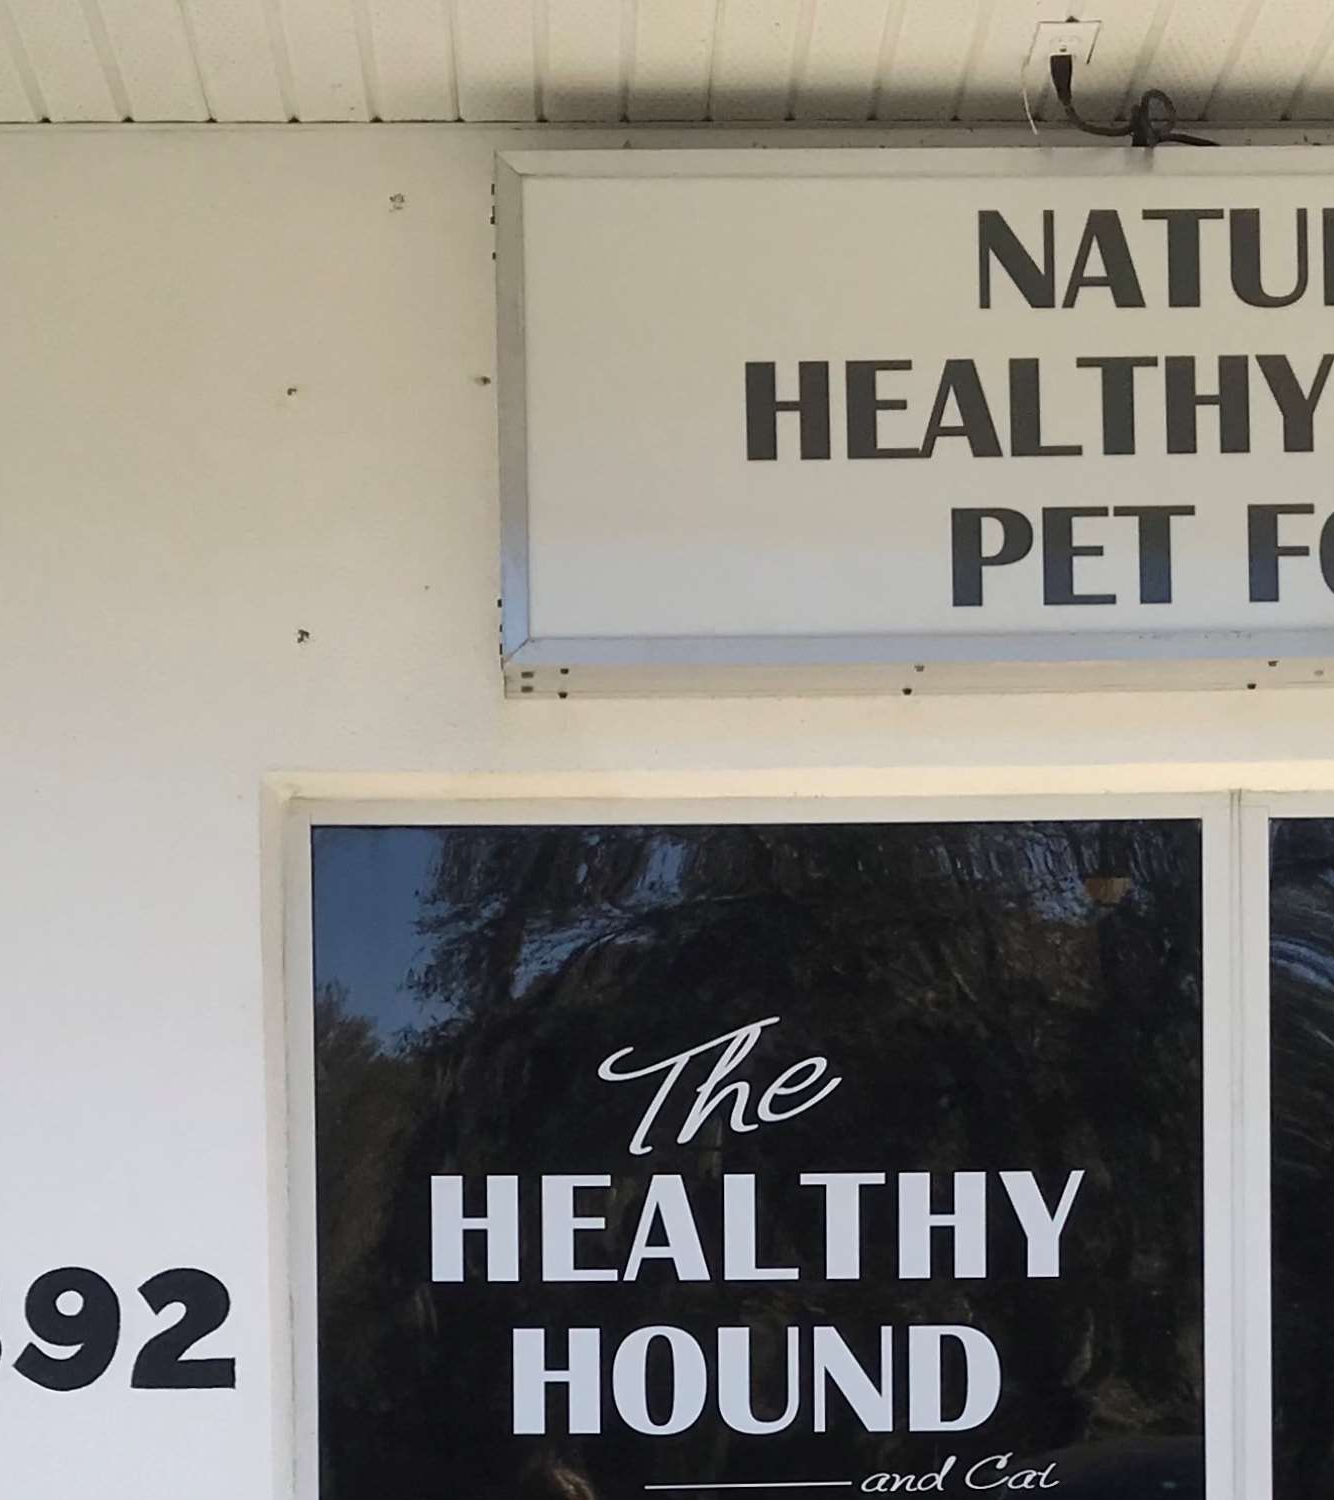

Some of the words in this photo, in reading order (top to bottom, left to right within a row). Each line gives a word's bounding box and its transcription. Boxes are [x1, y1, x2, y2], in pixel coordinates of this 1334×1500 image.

[745, 354, 1334, 461] HEALTHY
[951, 505, 1195, 607] PET
[598, 1017, 842, 1154] The
[431, 1170, 1084, 1281] HEALTHY
[513, 1326, 1000, 1434] HOUND
[861, 1456, 956, 1492] and
[965, 1453, 1059, 1489] Cat
